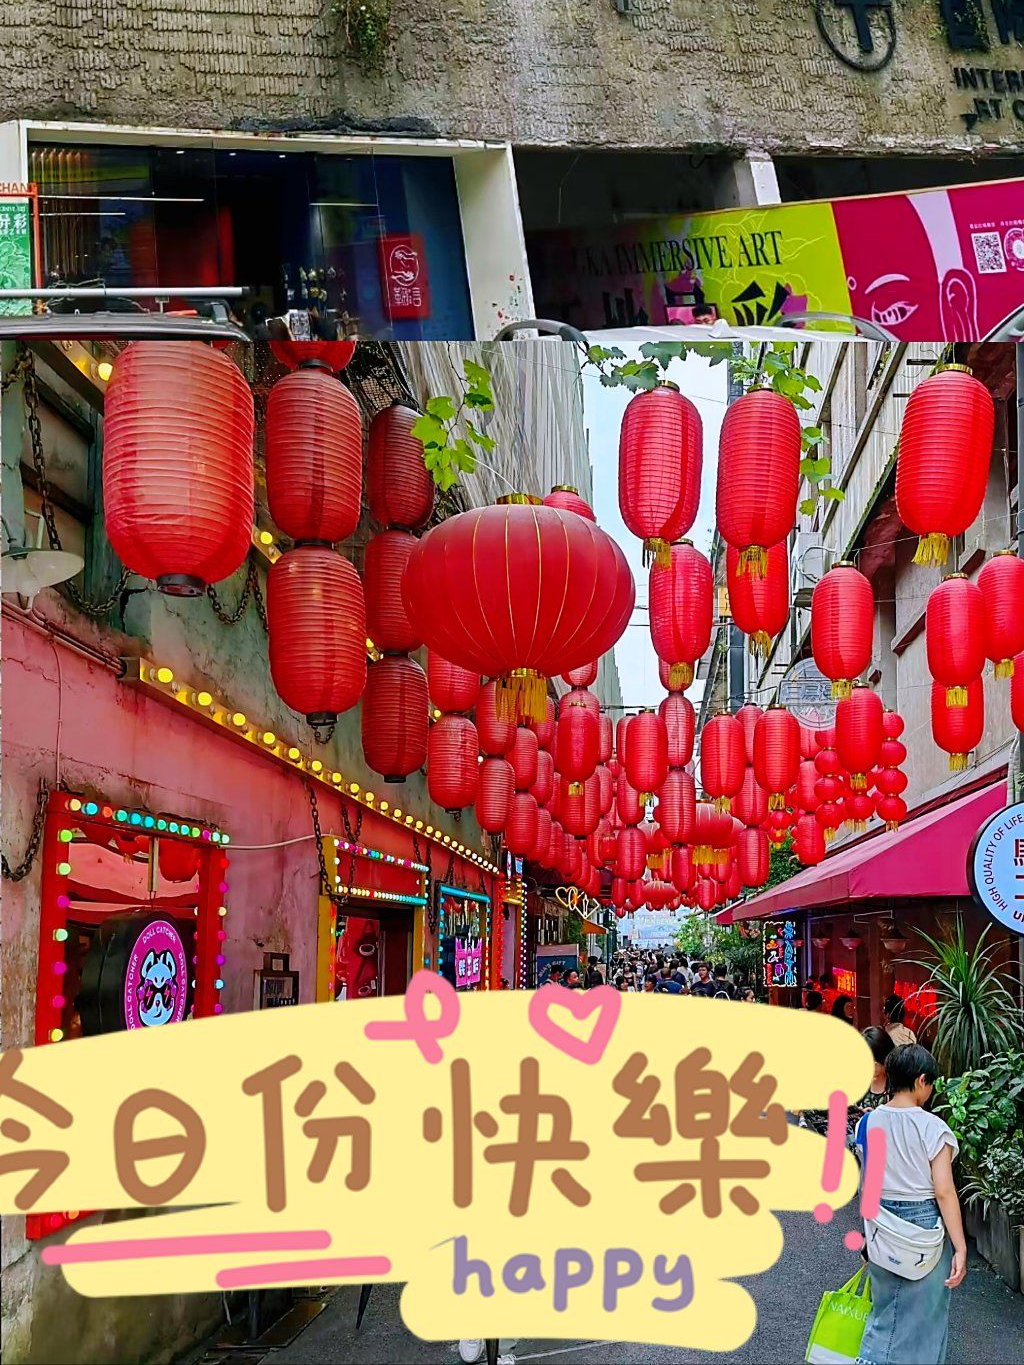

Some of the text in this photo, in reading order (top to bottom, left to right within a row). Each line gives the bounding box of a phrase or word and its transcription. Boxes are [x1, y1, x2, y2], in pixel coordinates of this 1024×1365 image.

[953, 67, 1024, 94] INTER
[737, 230, 785, 267] ART
[1004, 813, 1023, 830] LIFE
[993, 827, 1005, 842] OF
[984, 840, 997, 886] QUALITY
[988, 886, 1009, 911] HIGH
[142, 928, 156, 944] DOLL
